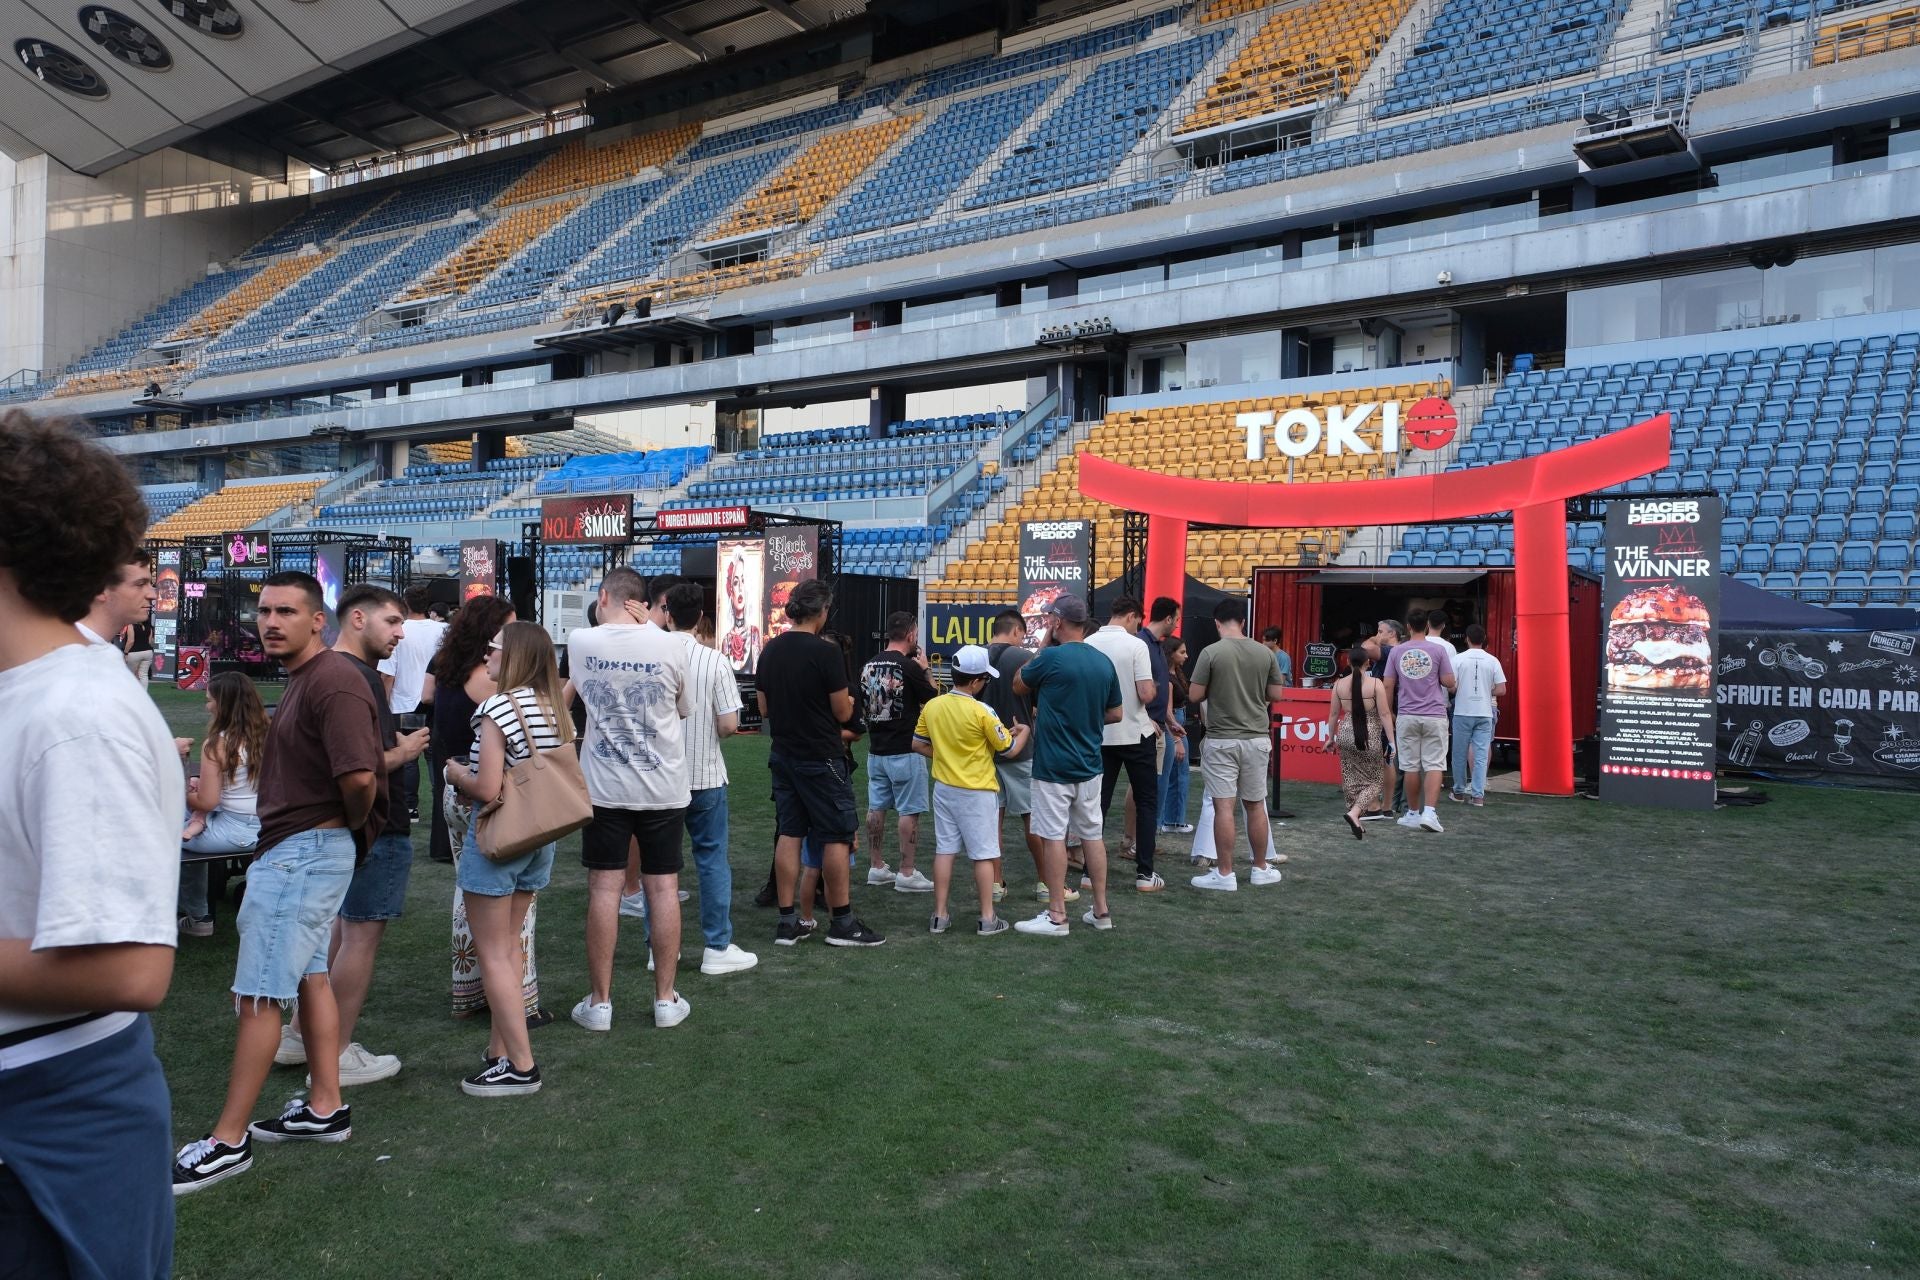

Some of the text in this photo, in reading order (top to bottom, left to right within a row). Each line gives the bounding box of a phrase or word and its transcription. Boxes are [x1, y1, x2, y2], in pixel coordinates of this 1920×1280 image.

[1629, 501, 1699, 513] HACER
[665, 513, 687, 527] BURGER
[688, 512, 712, 526] KAMADO
[713, 511, 721, 524] DE
[722, 508, 745, 524] ESPAÑA
[1628, 512, 1700, 524] PEDIDO
[544, 517, 583, 539] NOLA
[585, 515, 626, 537] SMOKE
[1027, 521, 1083, 531] RECOGER
[1033, 530, 1076, 539] PEDIDO
[769, 534, 806, 555] Black
[1615, 546, 1648, 559] THE
[774, 551, 812, 573] Rose
[1024, 556, 1045, 566] THE
[1024, 566, 1081, 580] WINNER
[1614, 559, 1710, 577] WINNER
[1311, 657, 1328, 665] Uber
[1717, 684, 1920, 712] SFRUTE EN CADA PAR
[1282, 744, 1295, 752] OY
[1785, 751, 1818, 762] Cheers!
